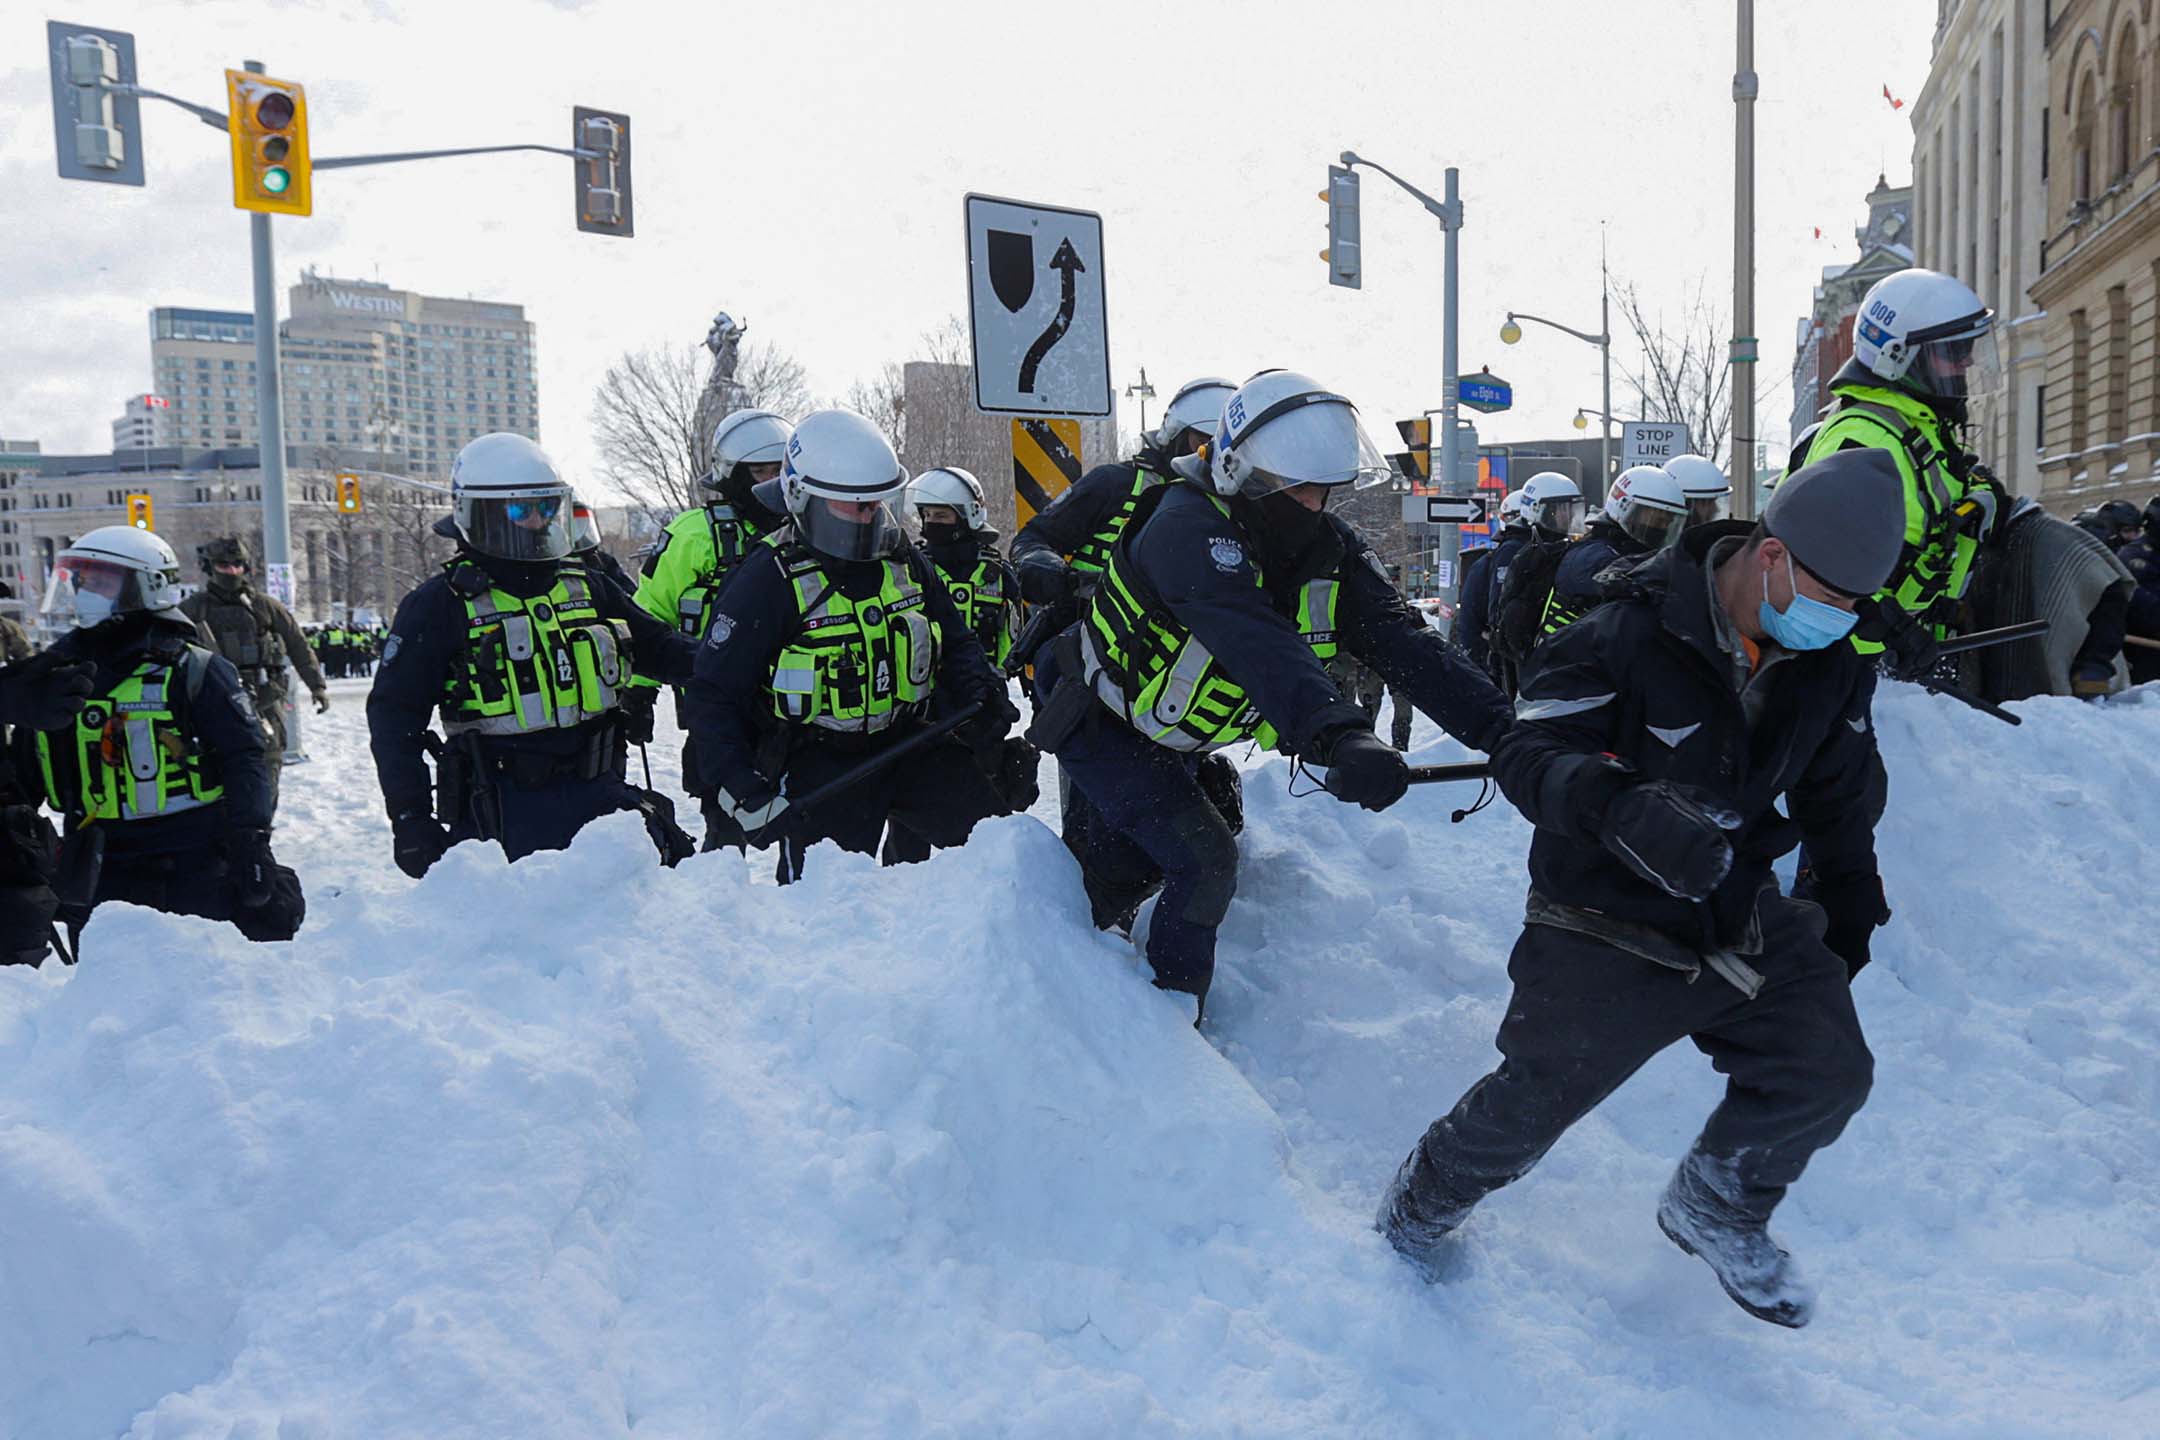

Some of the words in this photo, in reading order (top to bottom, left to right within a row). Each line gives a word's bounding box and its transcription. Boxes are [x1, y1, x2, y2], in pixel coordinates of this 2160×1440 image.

[328, 290, 404, 313] WESTIN
[1870, 300, 1897, 327] 008
[1229, 394, 1247, 430] 055
[1635, 429, 1674, 441] STOP
[1637, 444, 1671, 456] LINE
[559, 600, 589, 611] POLICE
[891, 597, 923, 612] POLICE
[557, 648, 570, 665] A
[558, 664, 574, 681] 12
[876, 660, 889, 677] A
[876, 676, 891, 692] 12
